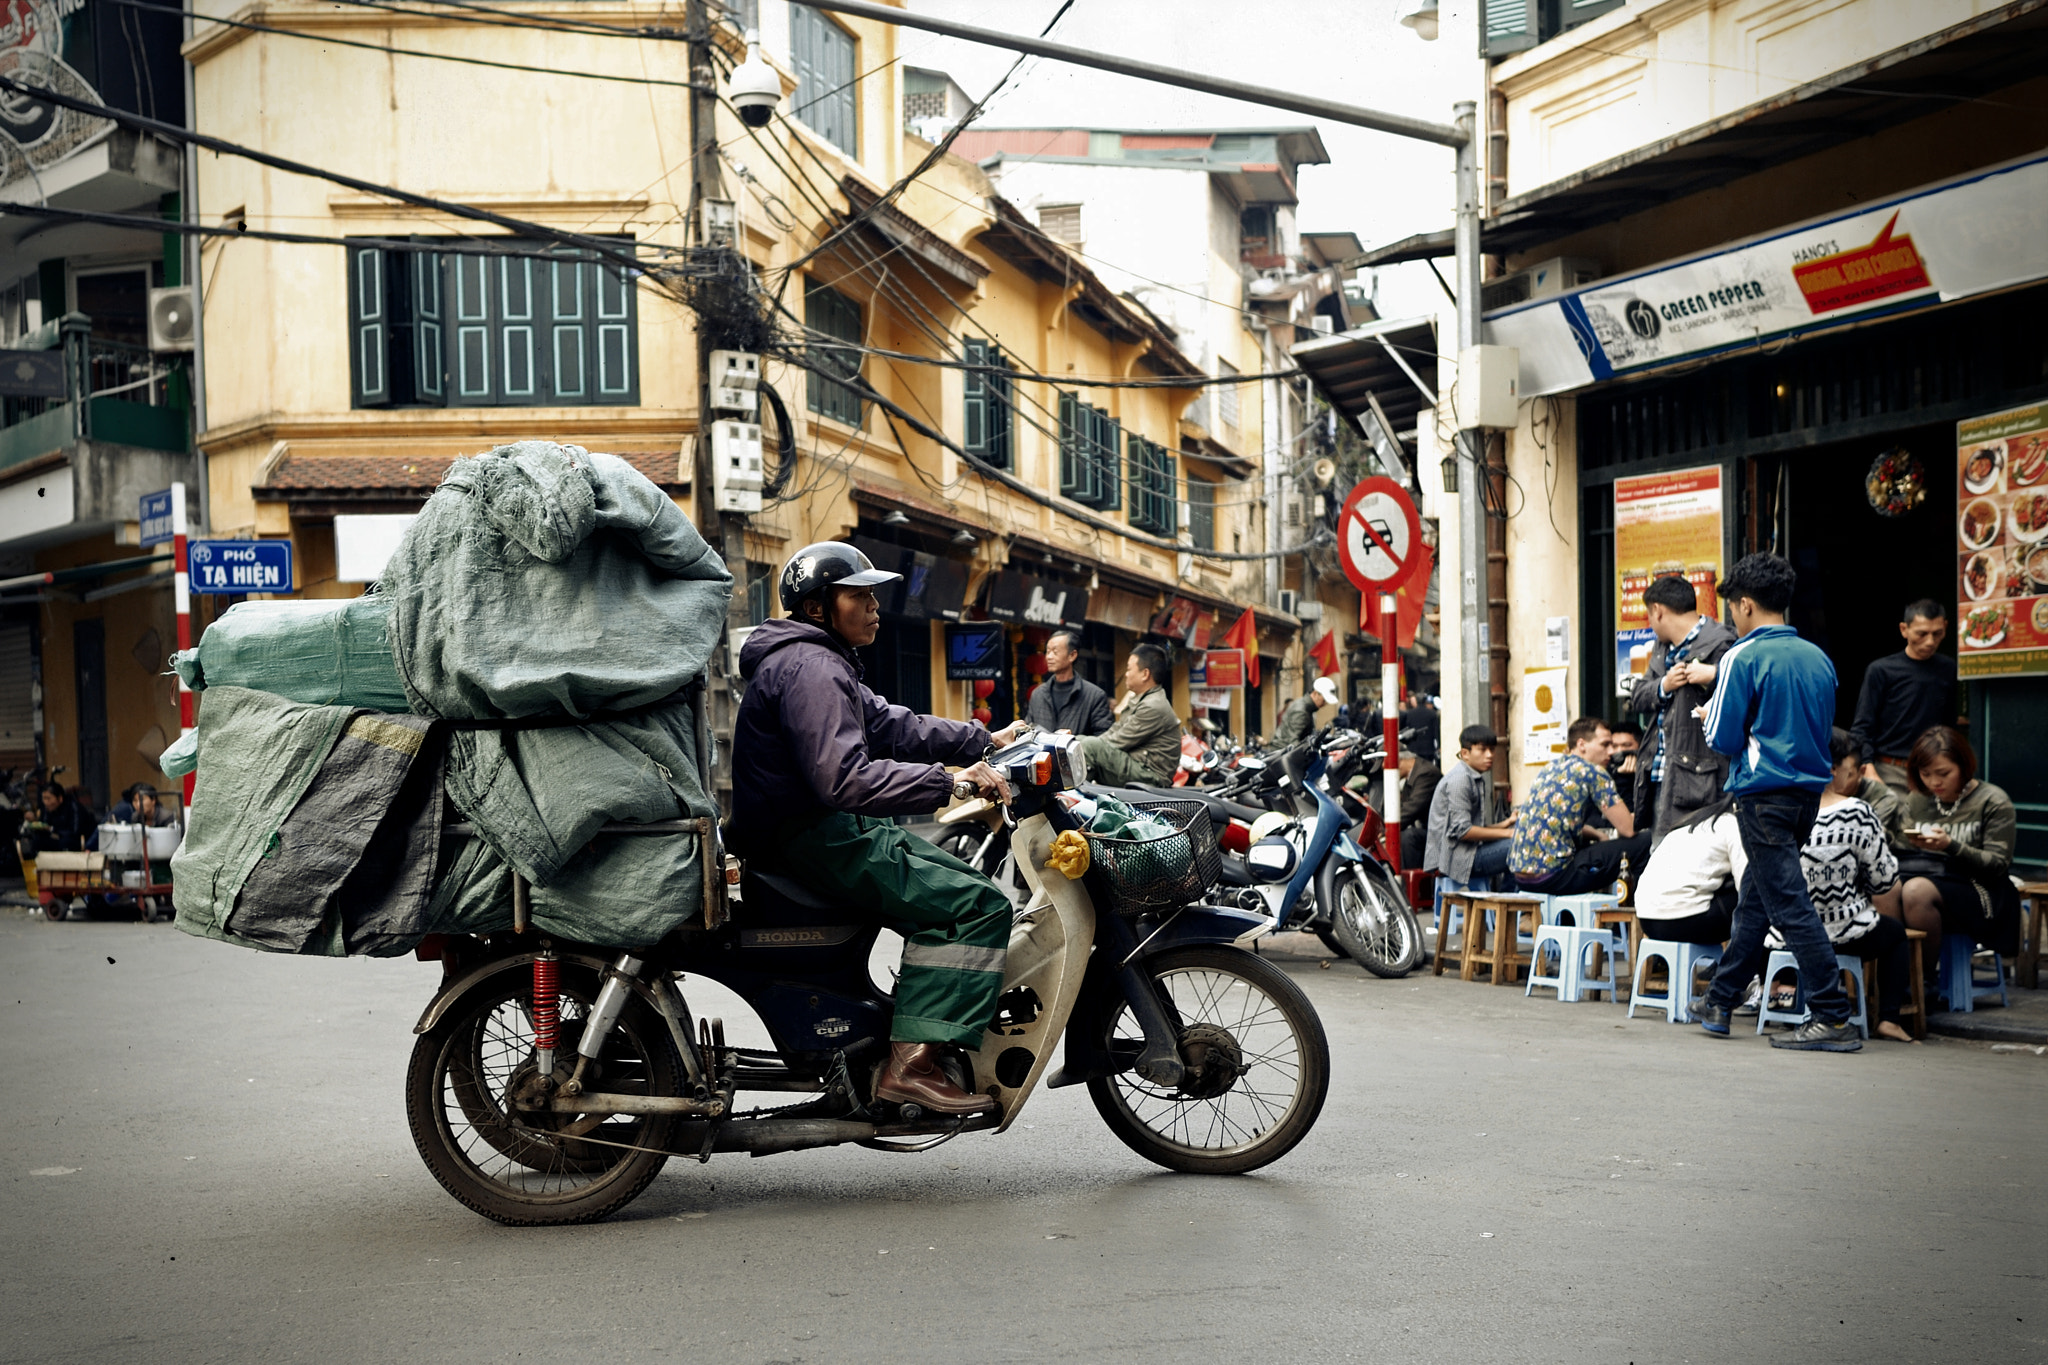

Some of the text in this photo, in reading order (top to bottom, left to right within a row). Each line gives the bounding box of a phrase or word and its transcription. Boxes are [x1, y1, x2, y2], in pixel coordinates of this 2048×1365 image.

[1792, 239, 1840, 263] HANOI'S
[1660, 280, 1765, 321] GREEN PEPPER
[223, 546, 256, 562] PHỐ
[202, 562, 279, 588] TẠ HIỆN
[952, 667, 995, 678] SKATESHOP
[756, 930, 825, 943] HONDA
[816, 1025, 850, 1036] CUB
